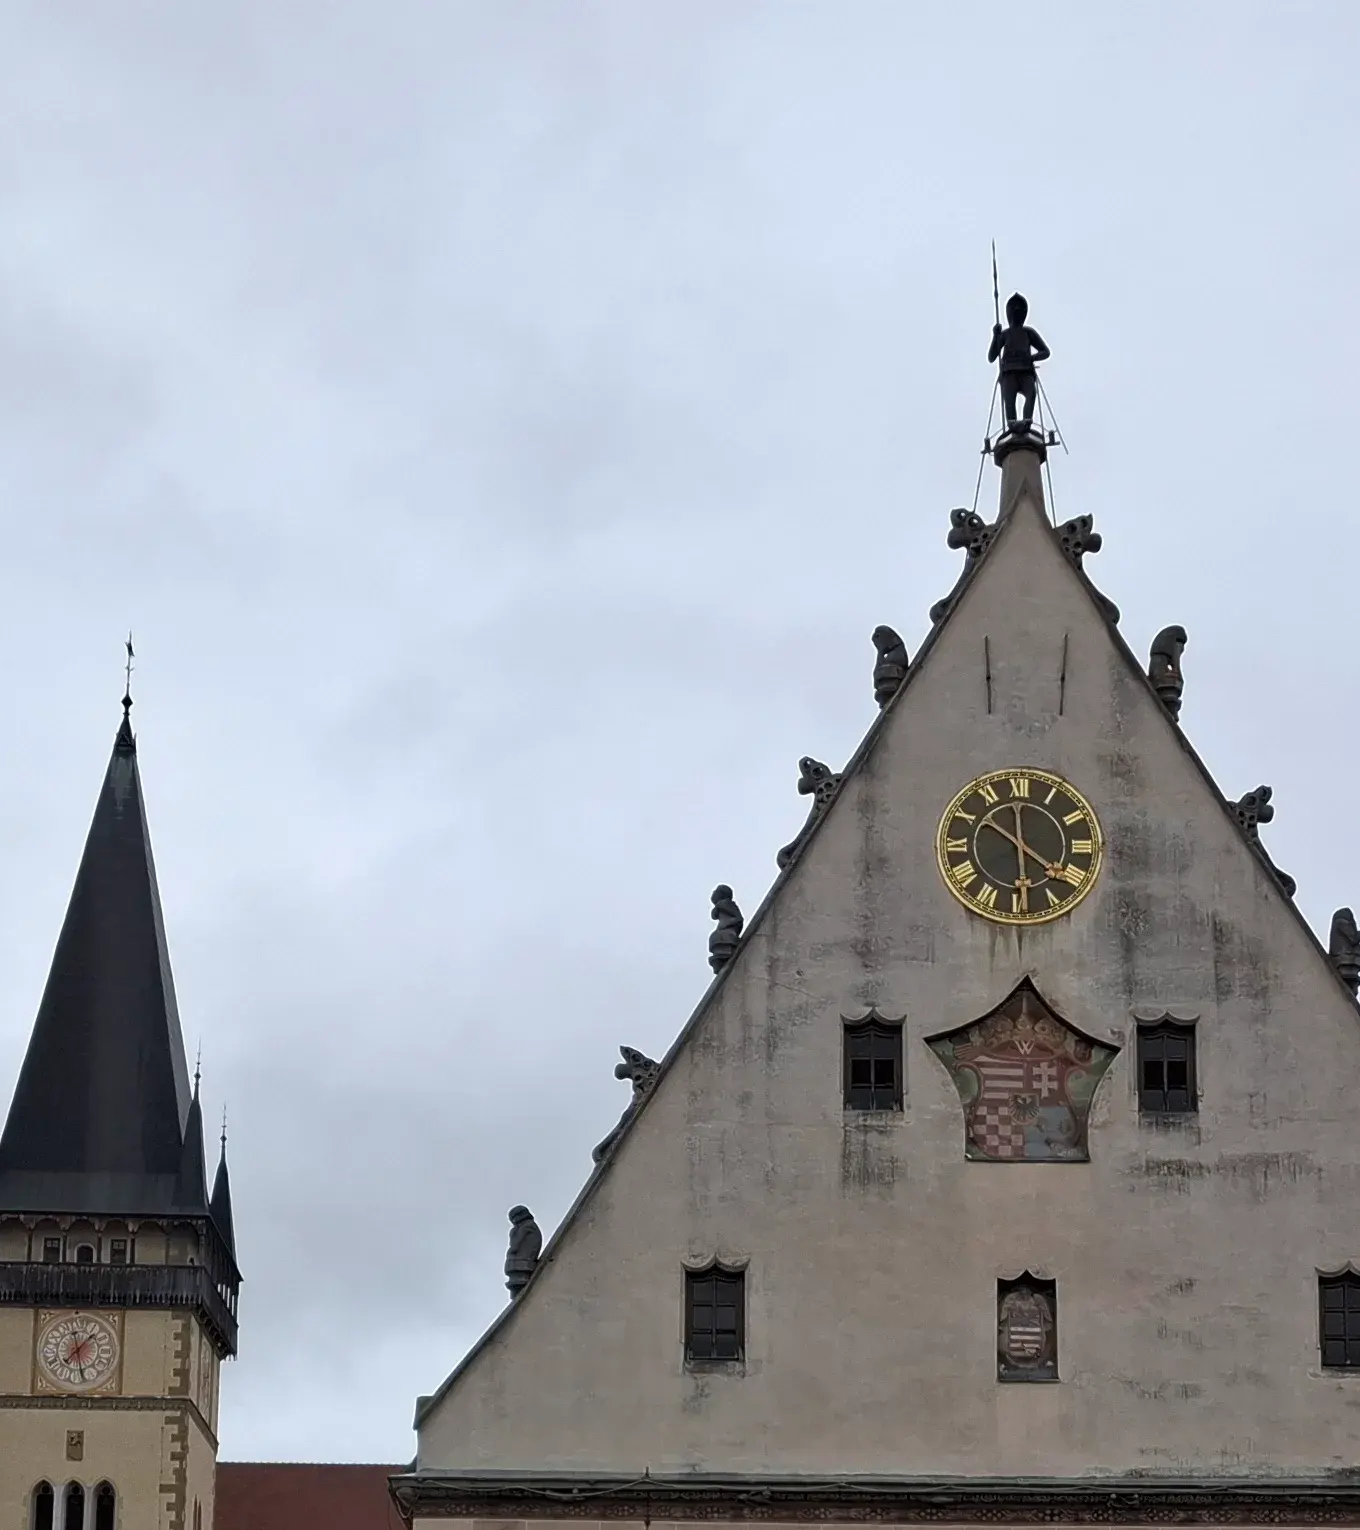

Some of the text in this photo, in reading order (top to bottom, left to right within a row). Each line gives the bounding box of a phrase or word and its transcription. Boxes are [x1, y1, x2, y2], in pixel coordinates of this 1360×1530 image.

[978, 784, 1000, 807] XI
[1009, 778, 1029, 798] XII
[1043, 787, 1057, 805] I
[954, 807, 976, 825] X
[1062, 809, 1084, 826] II
[947, 837, 968, 852] IX
[1071, 839, 1092, 854] III
[952, 860, 978, 888] VIII
[976, 882, 998, 908] VII
[1045, 887, 1061, 907] V
